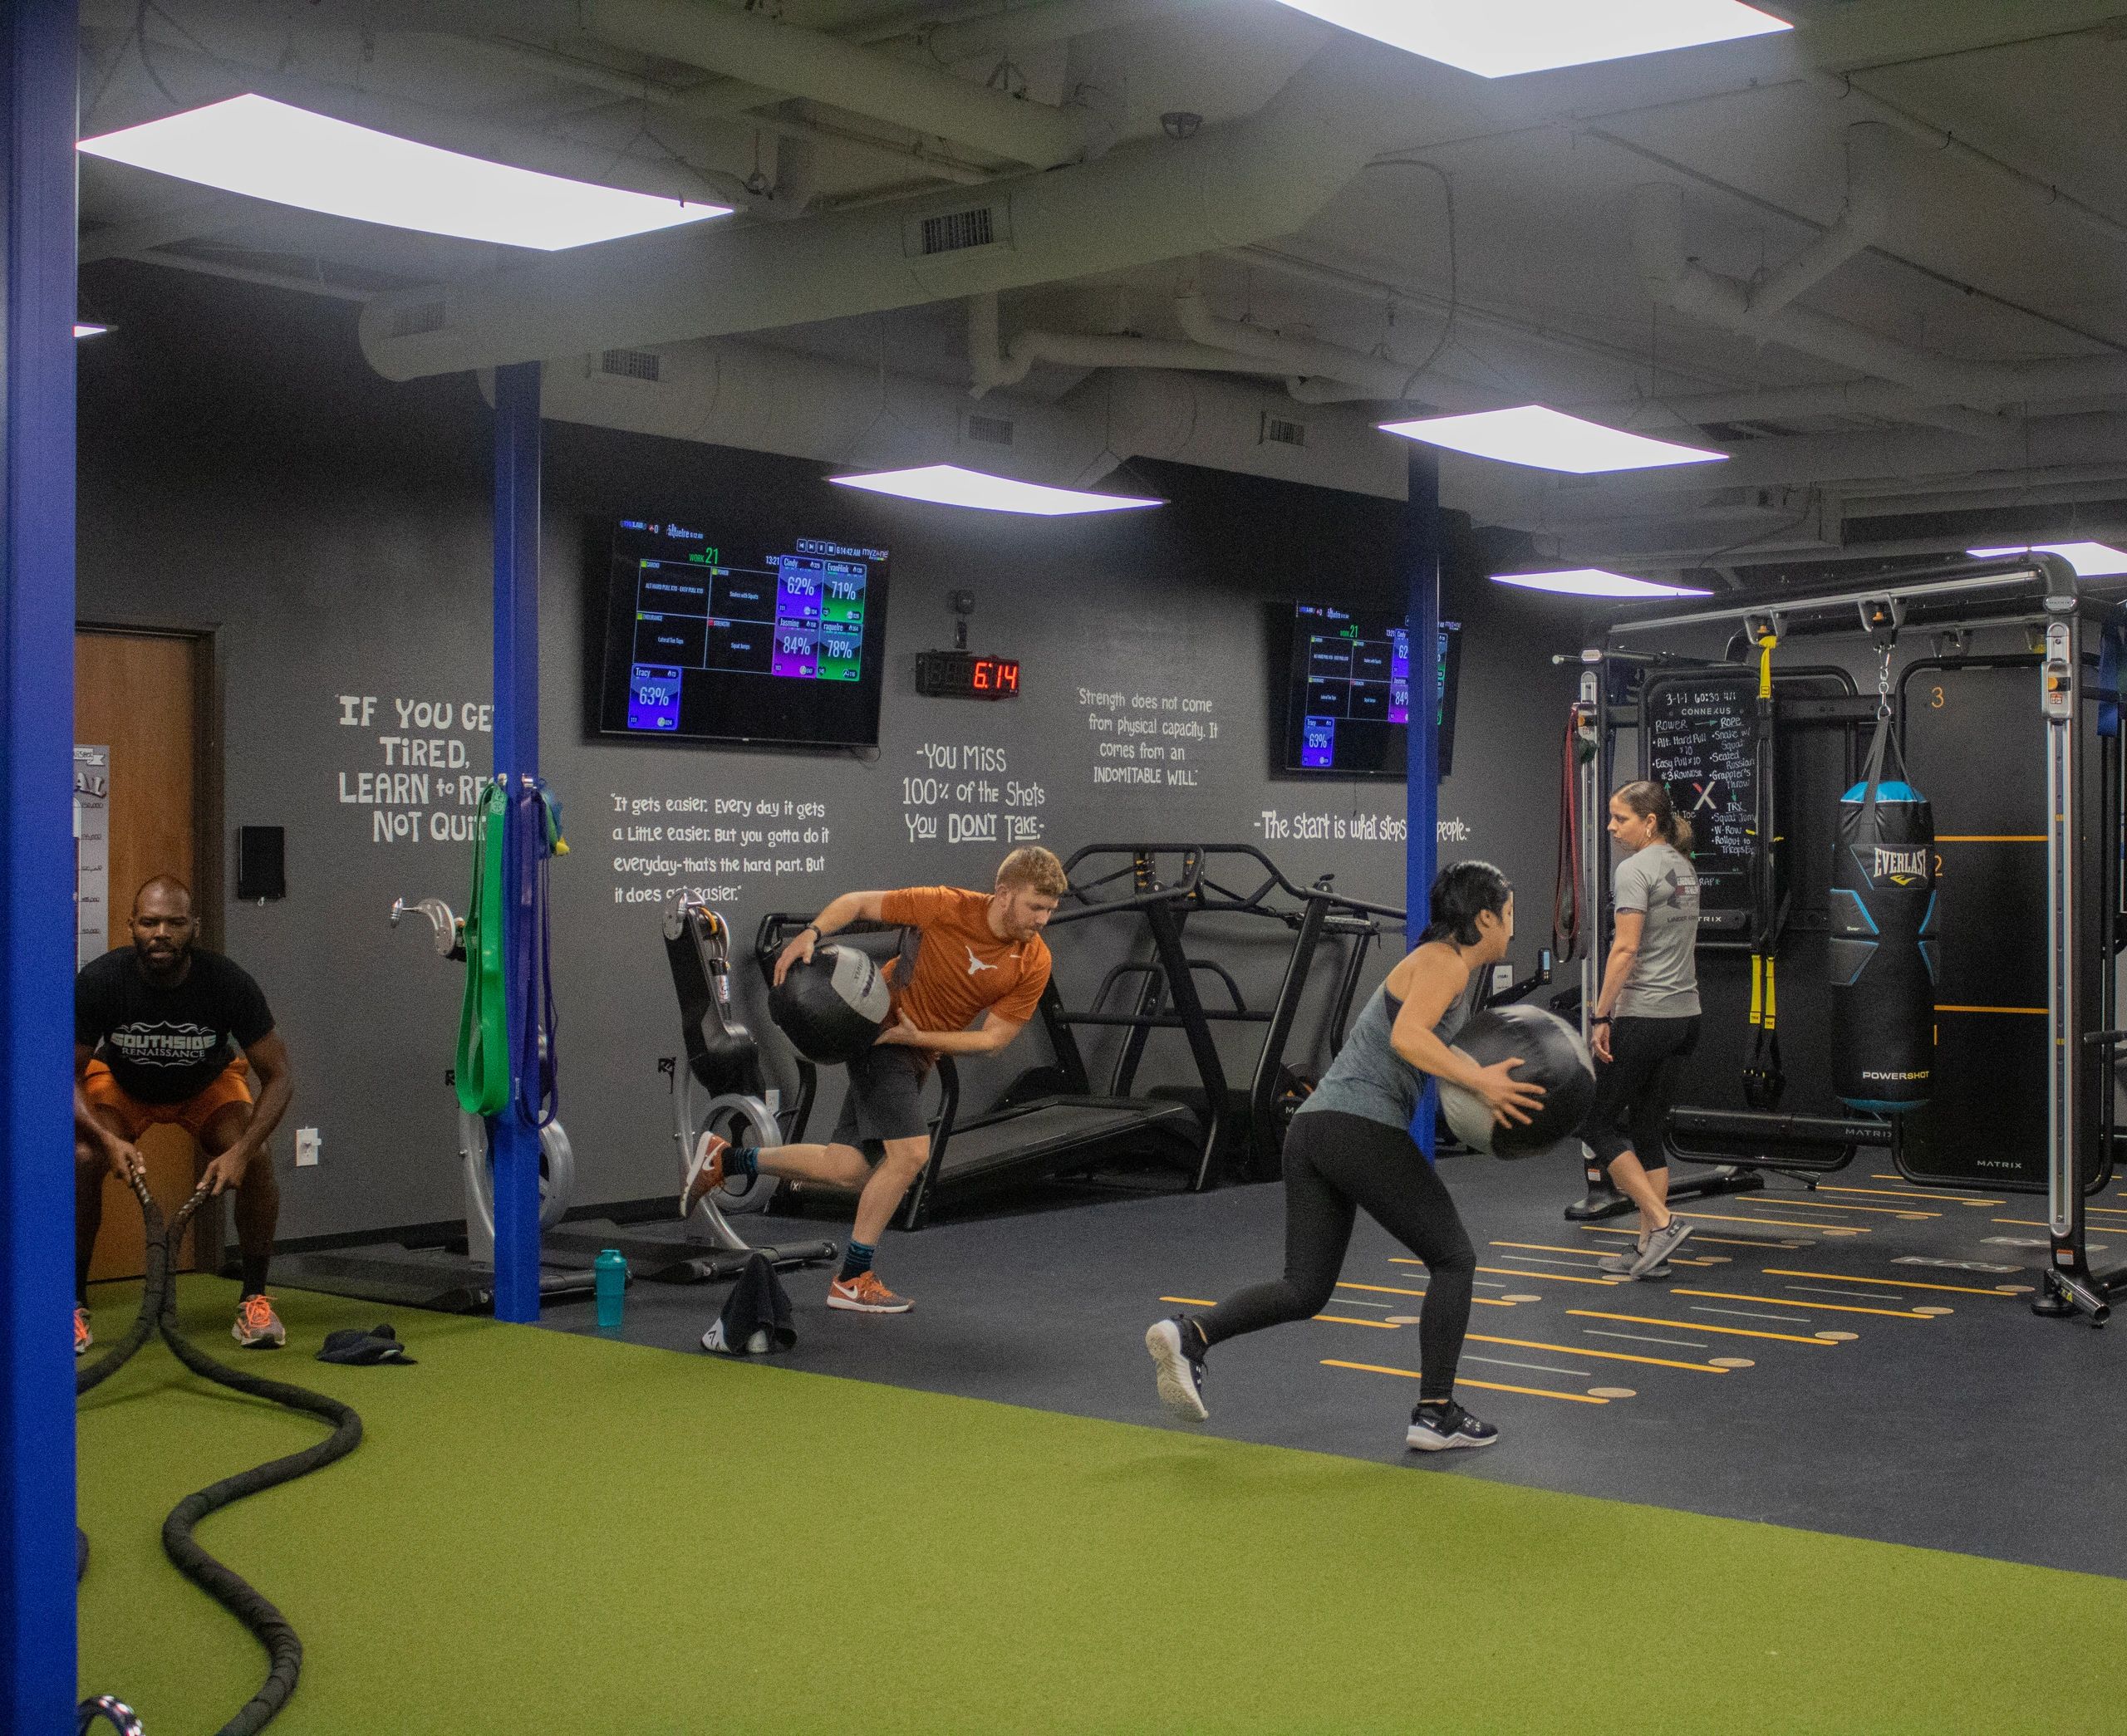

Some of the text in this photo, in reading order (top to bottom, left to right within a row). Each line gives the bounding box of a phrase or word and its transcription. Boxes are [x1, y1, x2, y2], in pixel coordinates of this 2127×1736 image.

[690, 547, 719, 565] WORK 21
[784, 557, 798, 568] Cindy
[787, 576, 814, 596] 62%
[832, 581, 856, 601] 71%
[1350, 625, 1358, 638] 21
[783, 636, 810, 655] 84%
[828, 640, 852, 659] 78%
[1399, 645, 1408, 660] 62
[636, 668, 651, 678] Tracy
[639, 687, 669, 706] 63%
[1132, 693, 1157, 709] does
[1162, 696, 1177, 710] not
[1182, 699, 1212, 713] come
[1932, 687, 1944, 708] 3
[395, 699, 453, 729] YOU
[461, 703, 494, 732] GE
[1089, 713, 1218, 741] from physical capacity. It
[1309, 733, 1327, 748] 63%
[1673, 734, 1692, 745] Hard
[1693, 733, 1706, 744] Pull
[1099, 742, 1185, 760] comes from an
[1712, 750, 1739, 762] Seated
[1656, 758, 1673, 771] Easy
[1727, 758, 1755, 770] Russian
[1093, 767, 1162, 783] INDOMITABLE
[339, 772, 430, 804] LEARN
[436, 778, 454, 797] to
[903, 777, 949, 805] 100%
[632, 798, 661, 815] gets
[666, 797, 708, 812] easier.
[715, 799, 751, 817] Every
[756, 800, 779, 817] day
[784, 800, 793, 816] it
[797, 802, 825, 820] gets
[1727, 802, 1742, 812] TRX
[373, 811, 422, 843] NOT
[1334, 815, 1345, 839] is
[1351, 814, 1377, 840] what
[1379, 814, 1407, 841] stops
[1713, 813, 1757, 825] Squat Jum
[612, 828, 623, 841] a
[667, 826, 711, 841] easier.
[715, 828, 737, 843] But
[740, 831, 763, 846] you
[768, 829, 800, 847] gotta
[803, 827, 819, 843] do
[822, 827, 830, 843] it
[720, 858, 740, 872] the
[744, 857, 772, 872] hard
[776, 857, 803, 875] part.
[806, 856, 825, 872] But
[1874, 847, 1927, 879] EVERLAST
[1934, 855, 1943, 876] 2
[615, 887, 623, 903] it
[626, 887, 662, 903] does
[111, 1032, 216, 1051] SOUTHSIDE
[121, 1047, 205, 1058] RENAISSANCE
[1862, 1071, 1929, 1080] POWERSHOT
[1977, 1160, 2022, 1169] MATRIX
